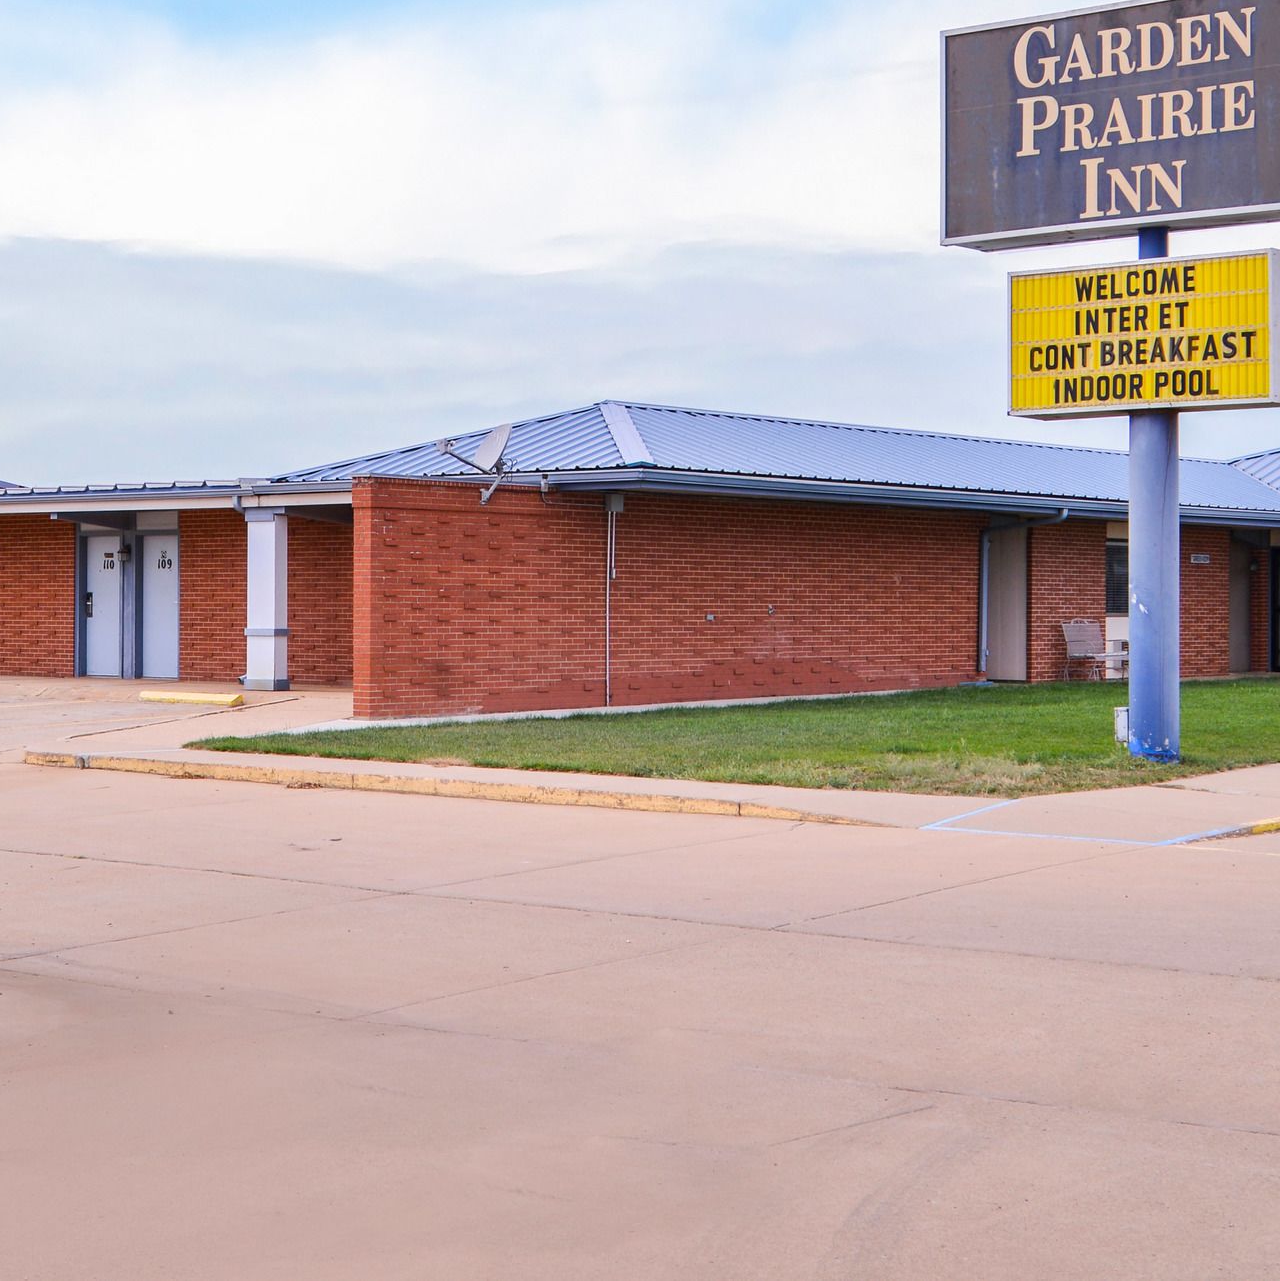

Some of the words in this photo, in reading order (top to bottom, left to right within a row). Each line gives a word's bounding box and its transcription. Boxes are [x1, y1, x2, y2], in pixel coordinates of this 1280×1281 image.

[1013, 6, 1256, 89] GARDEN
[1016, 80, 1256, 157] PRAIRIE
[1079, 157, 1187, 219] INN
[1075, 265, 1196, 302] WELCOME
[1074, 305, 1148, 336] INTER
[1029, 341, 1092, 372] CONT
[1100, 330, 1257, 367] BREAKFAST
[1053, 373, 1144, 404] INDOOR
[1154, 369, 1219, 398] POOL
[103, 559, 115, 570] 110
[157, 558, 173, 570] 109
